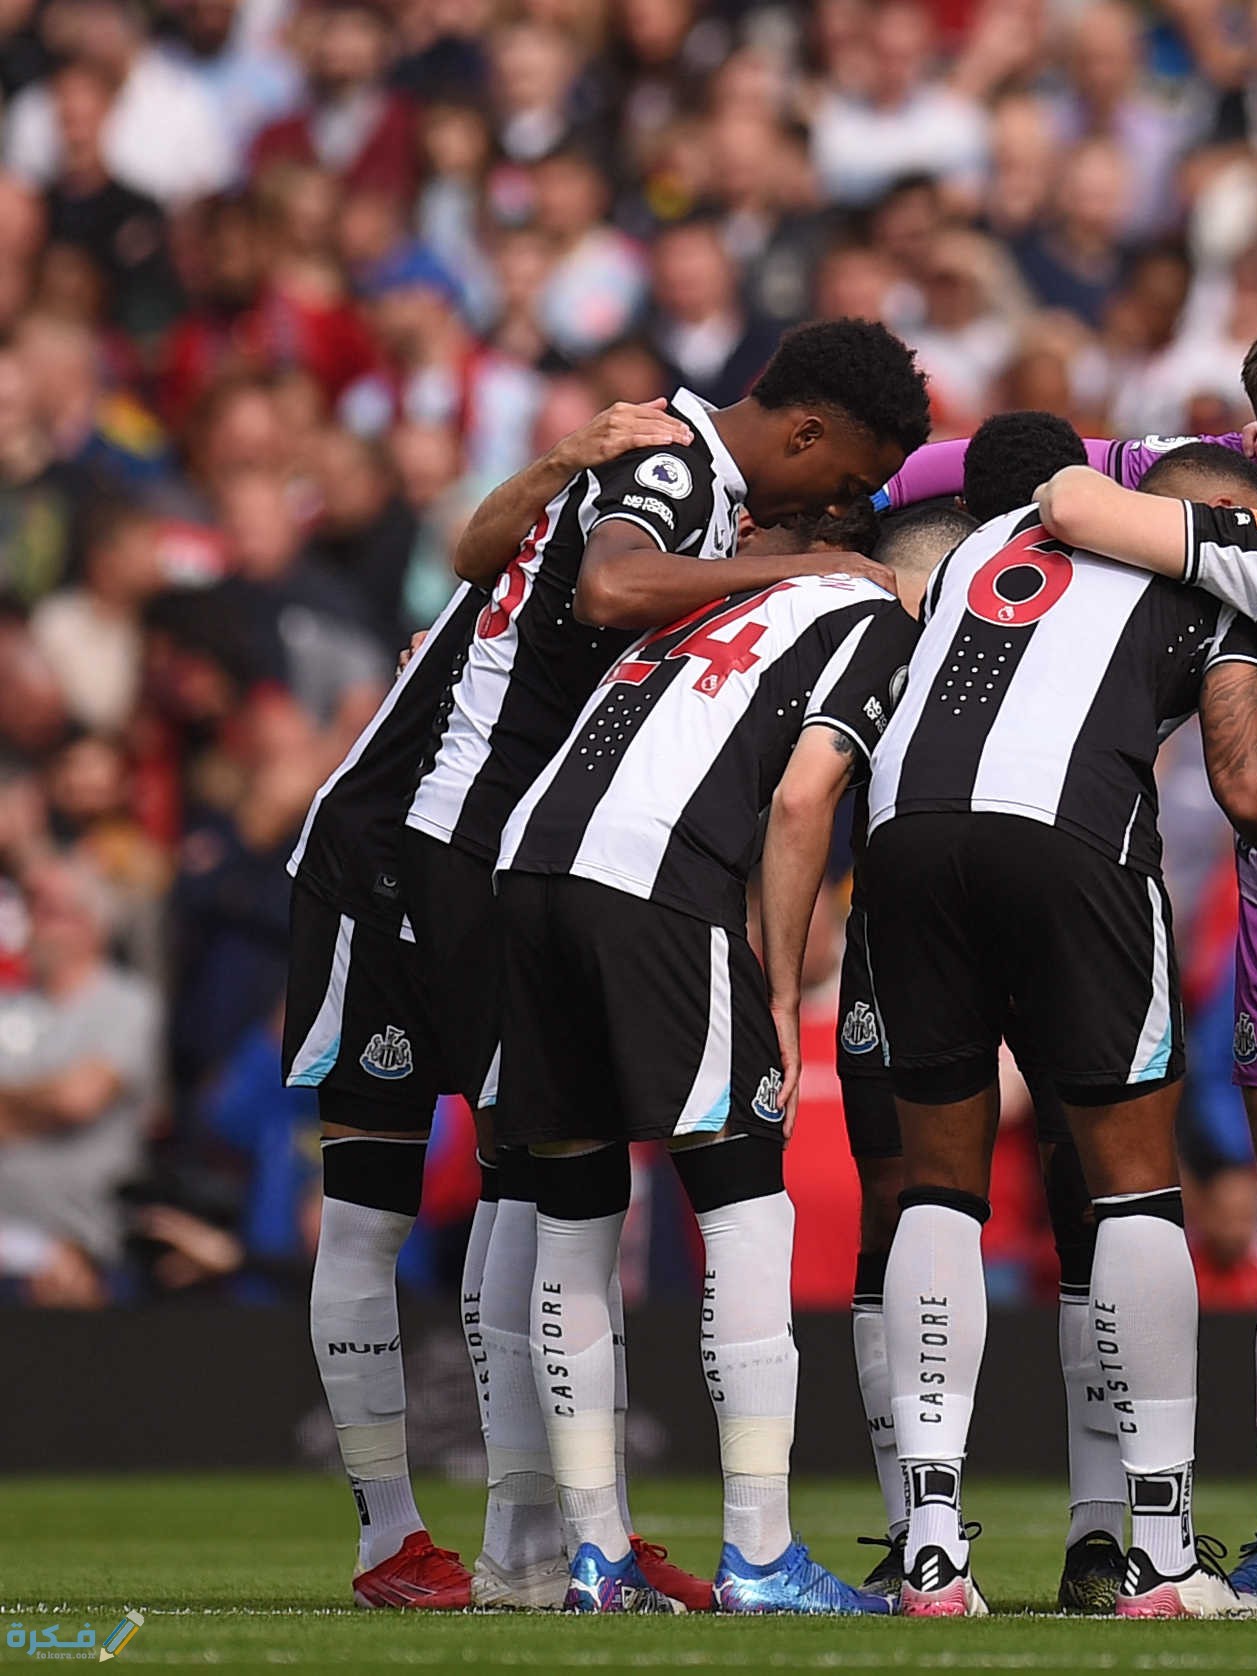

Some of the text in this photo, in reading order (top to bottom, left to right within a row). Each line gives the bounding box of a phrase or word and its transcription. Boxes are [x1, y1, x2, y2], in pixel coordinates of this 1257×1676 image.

[604, 581, 800, 700] 24
[966, 523, 1074, 627] 6
[541, 1281, 575, 1418] CASTORE
[702, 1269, 725, 1403] CASTORE
[919, 1295, 948, 1423] CASTORE
[1095, 1299, 1138, 1435] CASTORE
